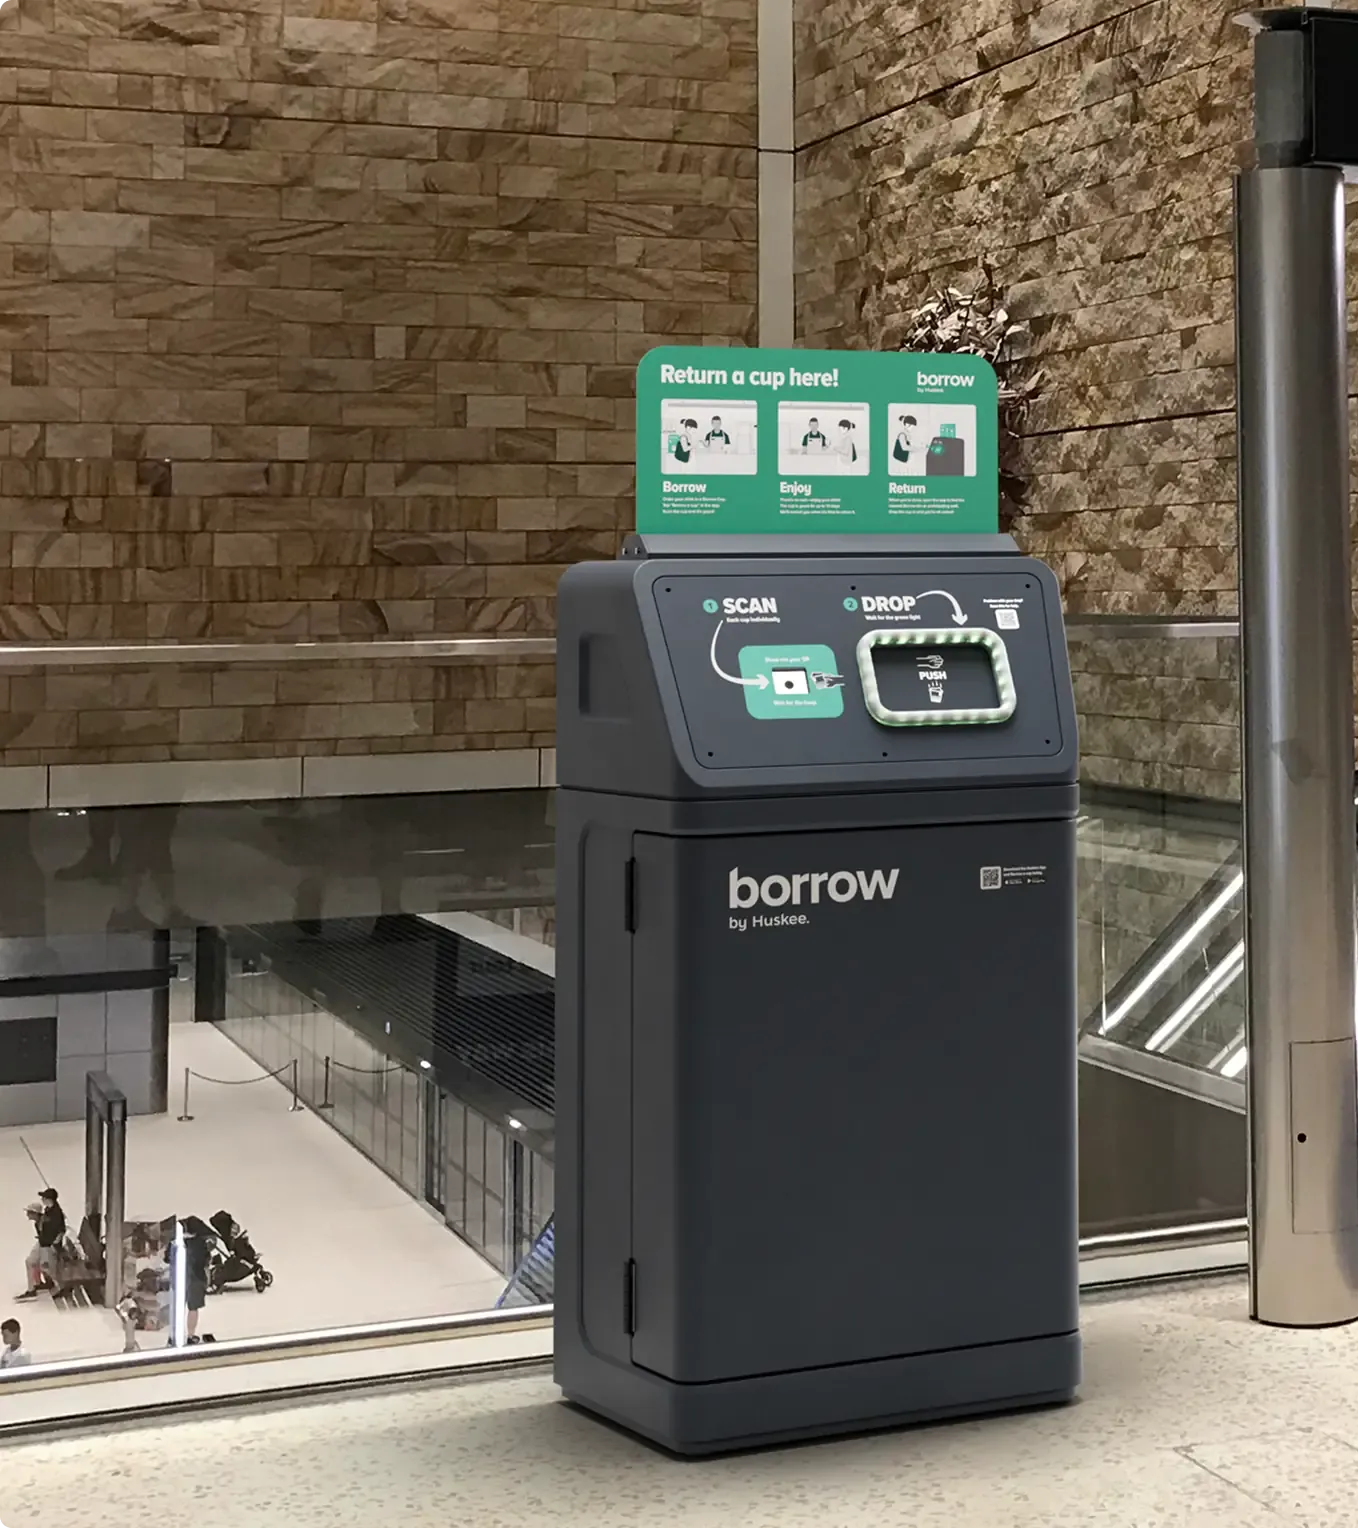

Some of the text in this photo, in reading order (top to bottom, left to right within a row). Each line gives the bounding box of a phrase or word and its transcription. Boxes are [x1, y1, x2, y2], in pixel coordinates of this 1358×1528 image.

[661, 364, 839, 391] Return a cup here!
[916, 371, 976, 388] borrow
[663, 480, 707, 493] Borrow
[779, 481, 812, 496] Enjoy
[888, 482, 926, 495] Return
[722, 597, 778, 614] SCAN
[861, 595, 916, 612] DROP
[918, 670, 948, 681] PUSH
[729, 866, 900, 909] borrow
[729, 913, 810, 932] by Huskee.
